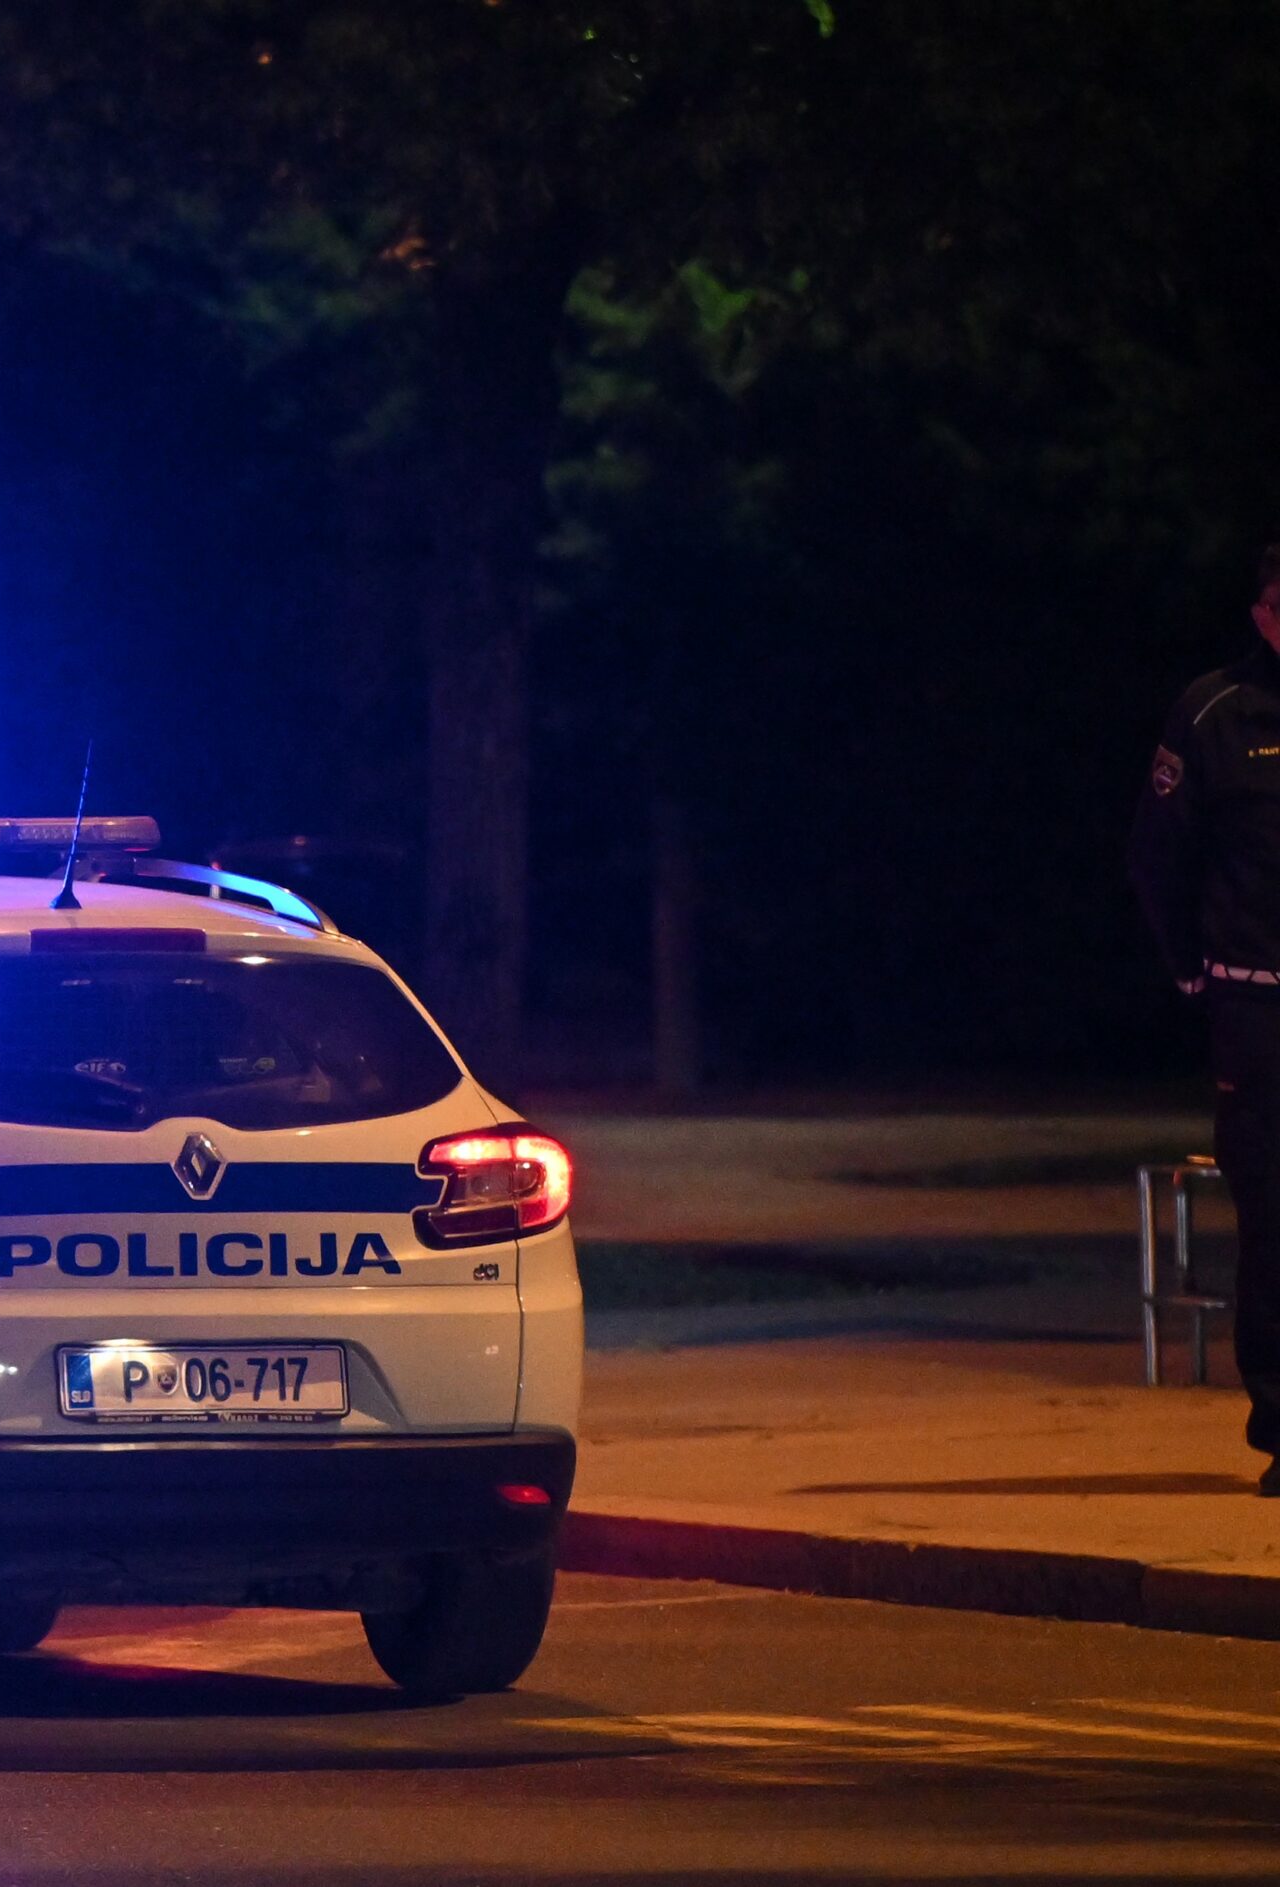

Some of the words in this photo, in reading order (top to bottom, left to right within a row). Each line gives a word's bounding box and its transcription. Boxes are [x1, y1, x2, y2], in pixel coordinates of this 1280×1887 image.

[71, 1390, 92, 1403] SLO
[122, 1360, 151, 1403] P
[185, 1357, 308, 1402] 06-717
